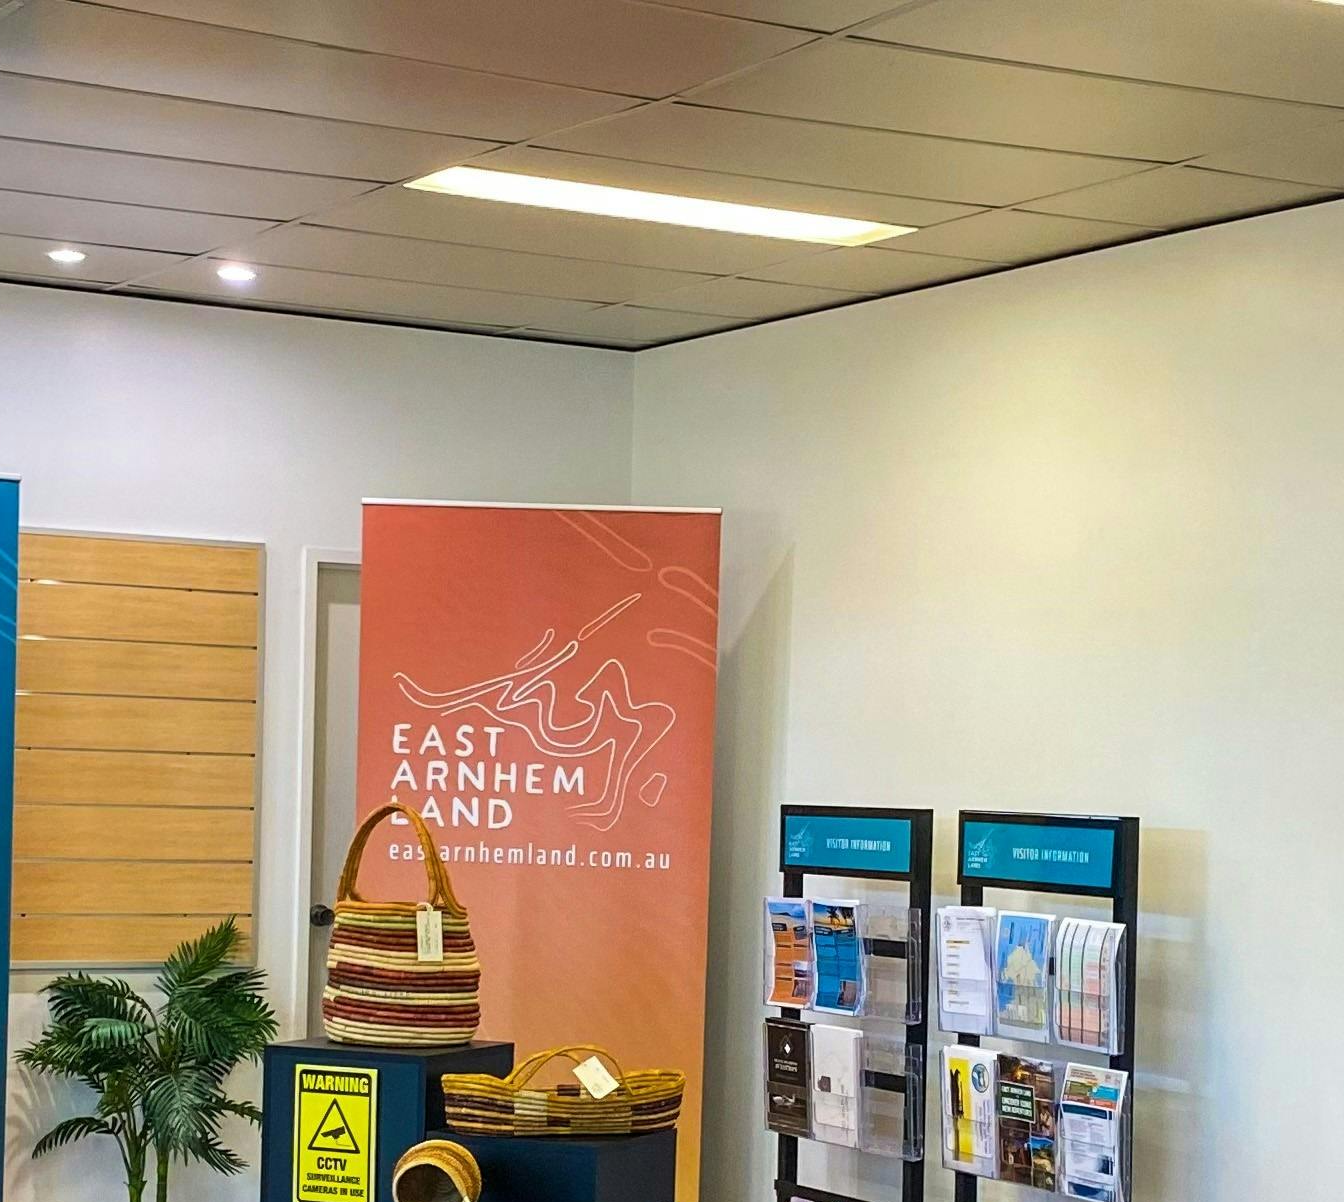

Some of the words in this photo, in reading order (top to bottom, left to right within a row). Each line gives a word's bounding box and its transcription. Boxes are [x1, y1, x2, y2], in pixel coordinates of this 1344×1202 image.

[393, 723, 506, 757] EAST
[391, 760, 585, 795] ARNHEM
[390, 796, 514, 829] LAND
[389, 840, 672, 870] easarnhemland.com.au
[1012, 847, 1039, 860] VISITOR
[1041, 849, 1089, 864] INFORMATION
[302, 1073, 369, 1094] WARNING
[317, 1156, 347, 1171] CCTV
[306, 1172, 360, 1185] SURVEILLANCE
[302, 1184, 338, 1195] CAMERAS
[340, 1188, 348, 1196] IN
[350, 1188, 364, 1197] USE
